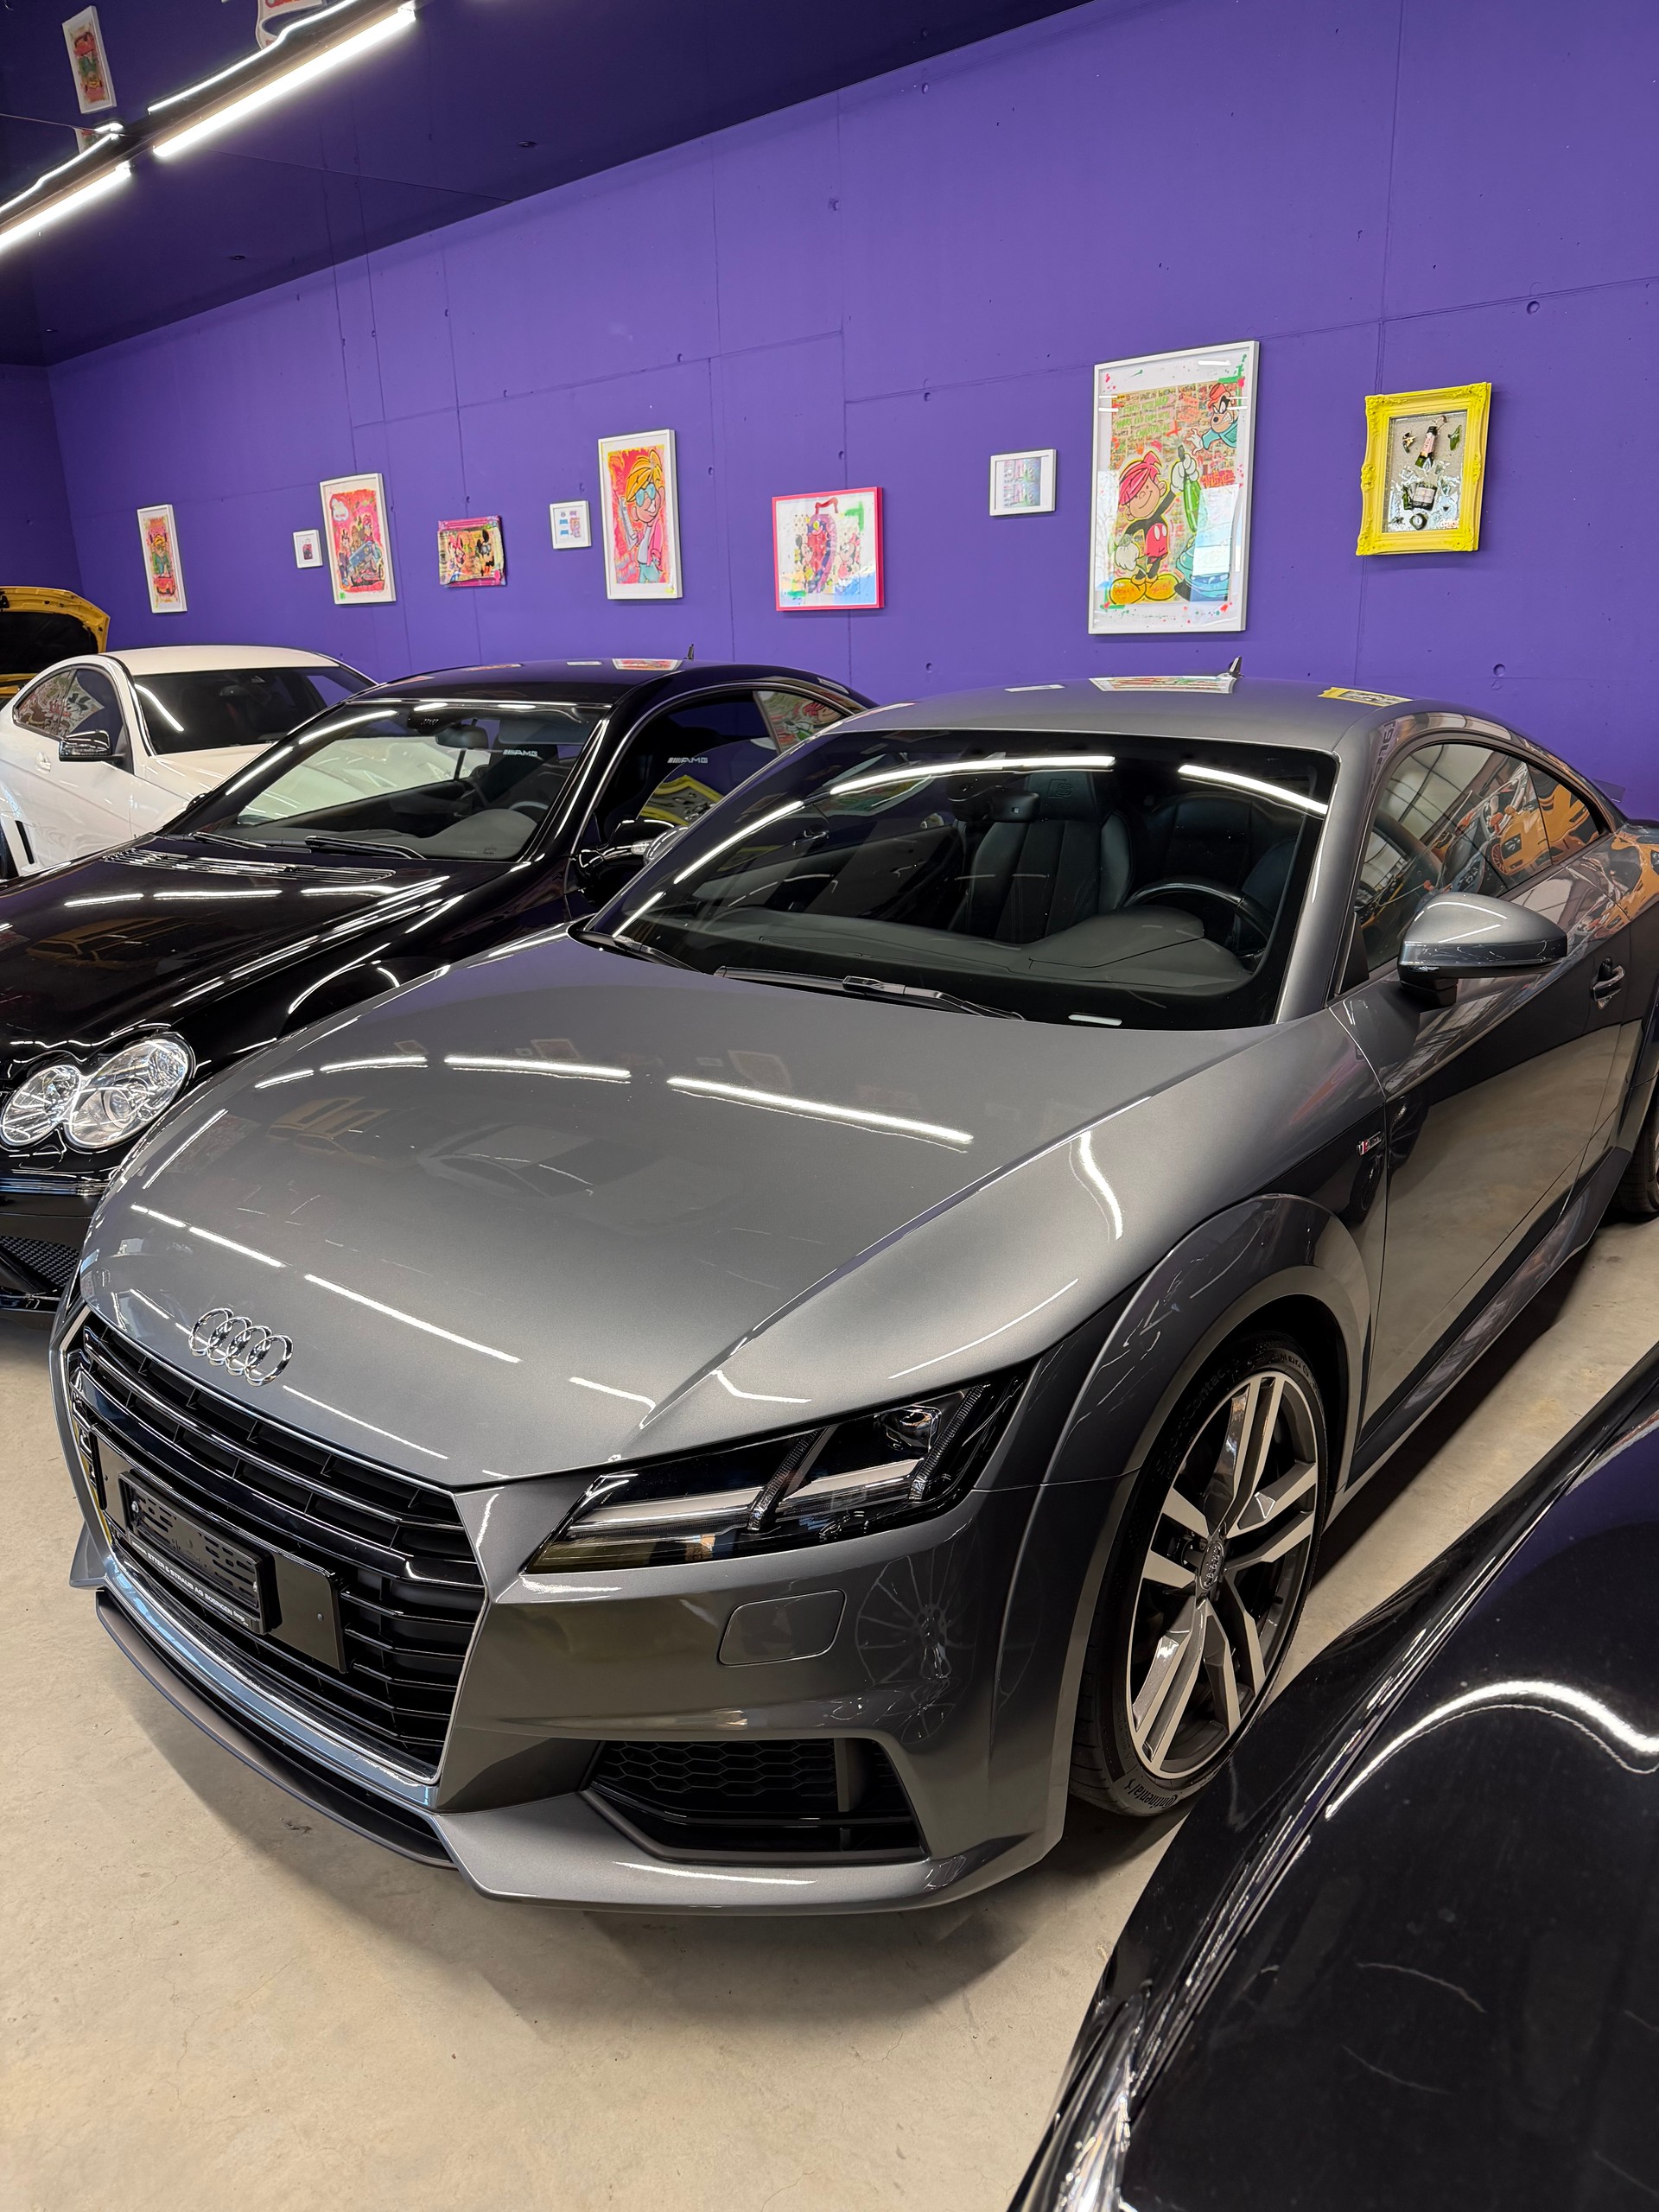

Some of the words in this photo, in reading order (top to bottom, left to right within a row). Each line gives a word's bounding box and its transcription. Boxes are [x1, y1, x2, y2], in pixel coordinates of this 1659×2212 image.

[148, 1552, 164, 1569] ETTER
[170, 1569, 194, 1590] STRAUB
[194, 1587, 204, 1597] AG
[1128, 1783, 1179, 1808] Continental
